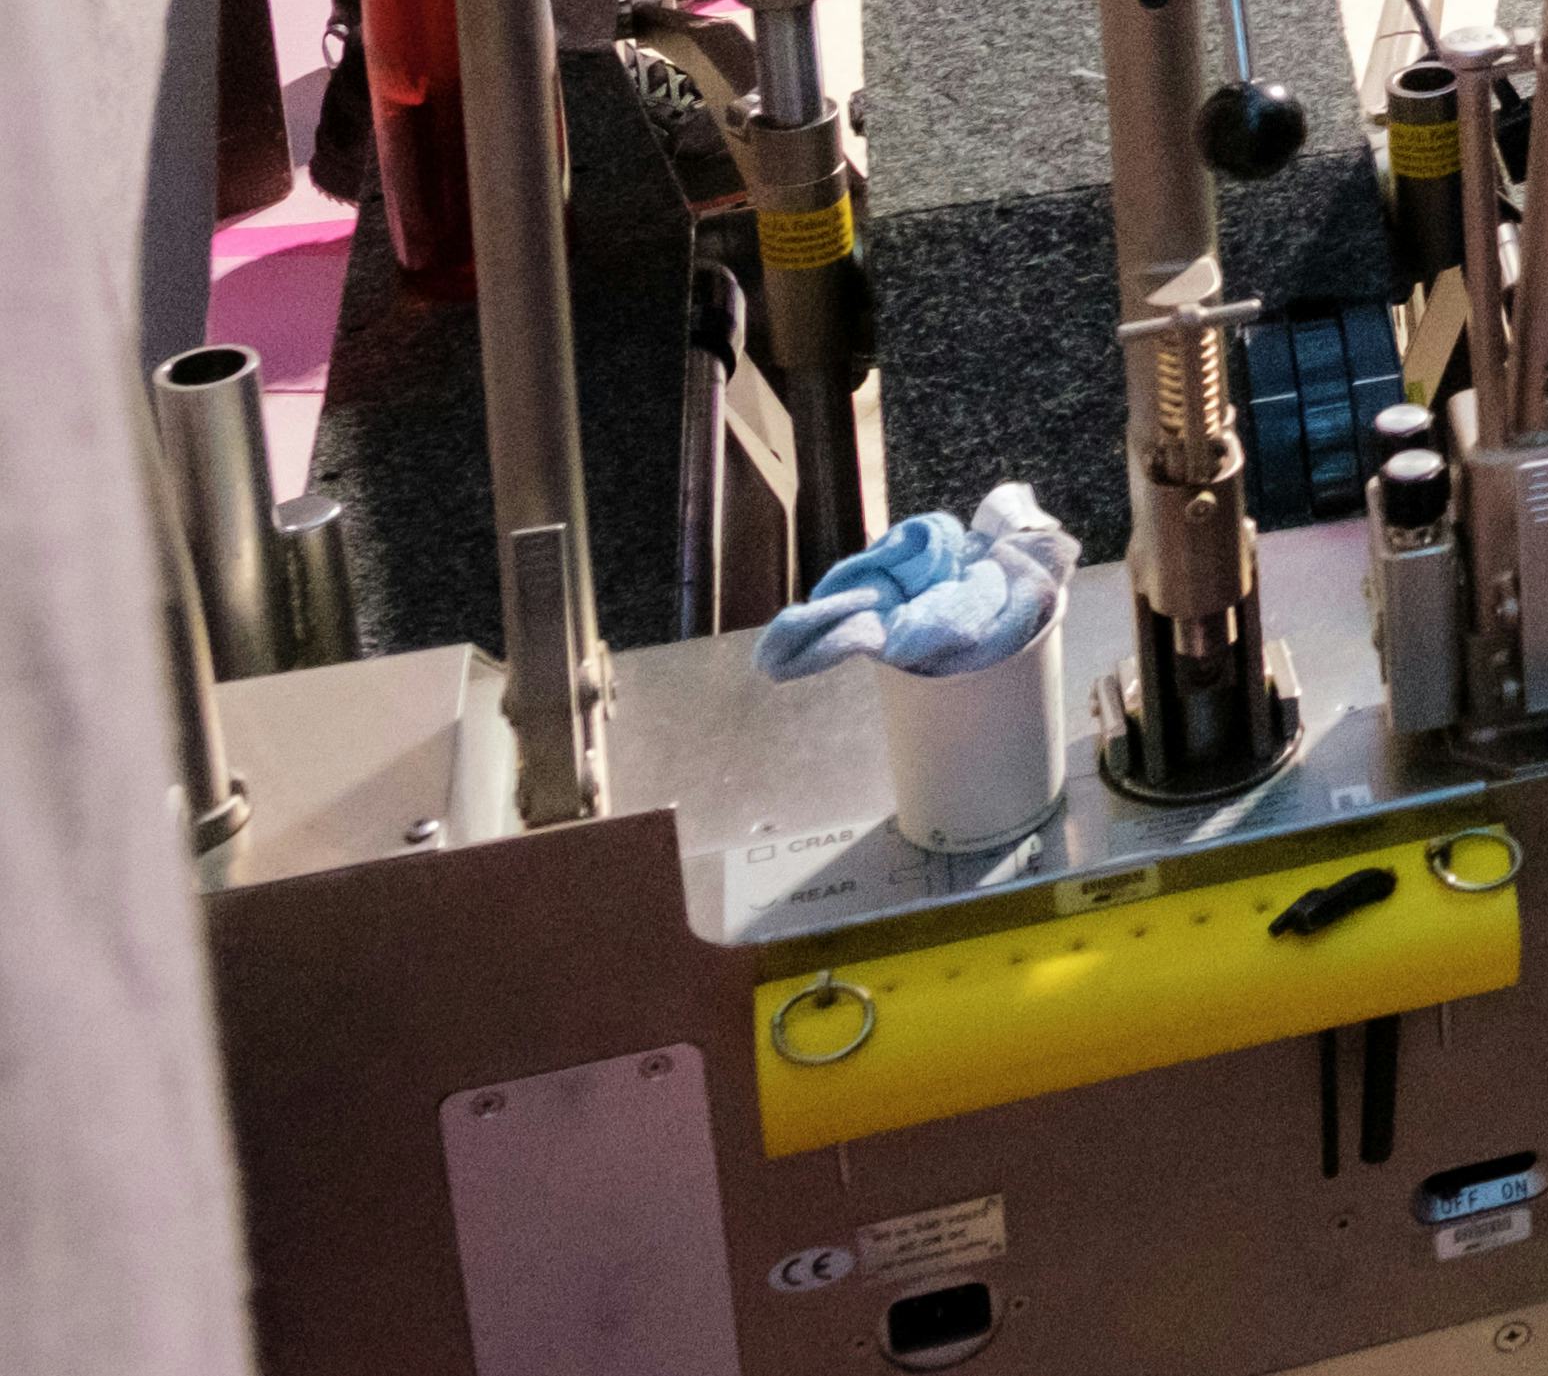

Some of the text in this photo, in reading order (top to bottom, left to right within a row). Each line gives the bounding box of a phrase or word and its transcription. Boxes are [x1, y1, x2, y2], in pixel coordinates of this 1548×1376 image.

[788, 830, 855, 853] CRAB
[790, 880, 857, 904] REAR
[1501, 1178, 1528, 1200] ON
[781, 1251, 833, 1286] CE
